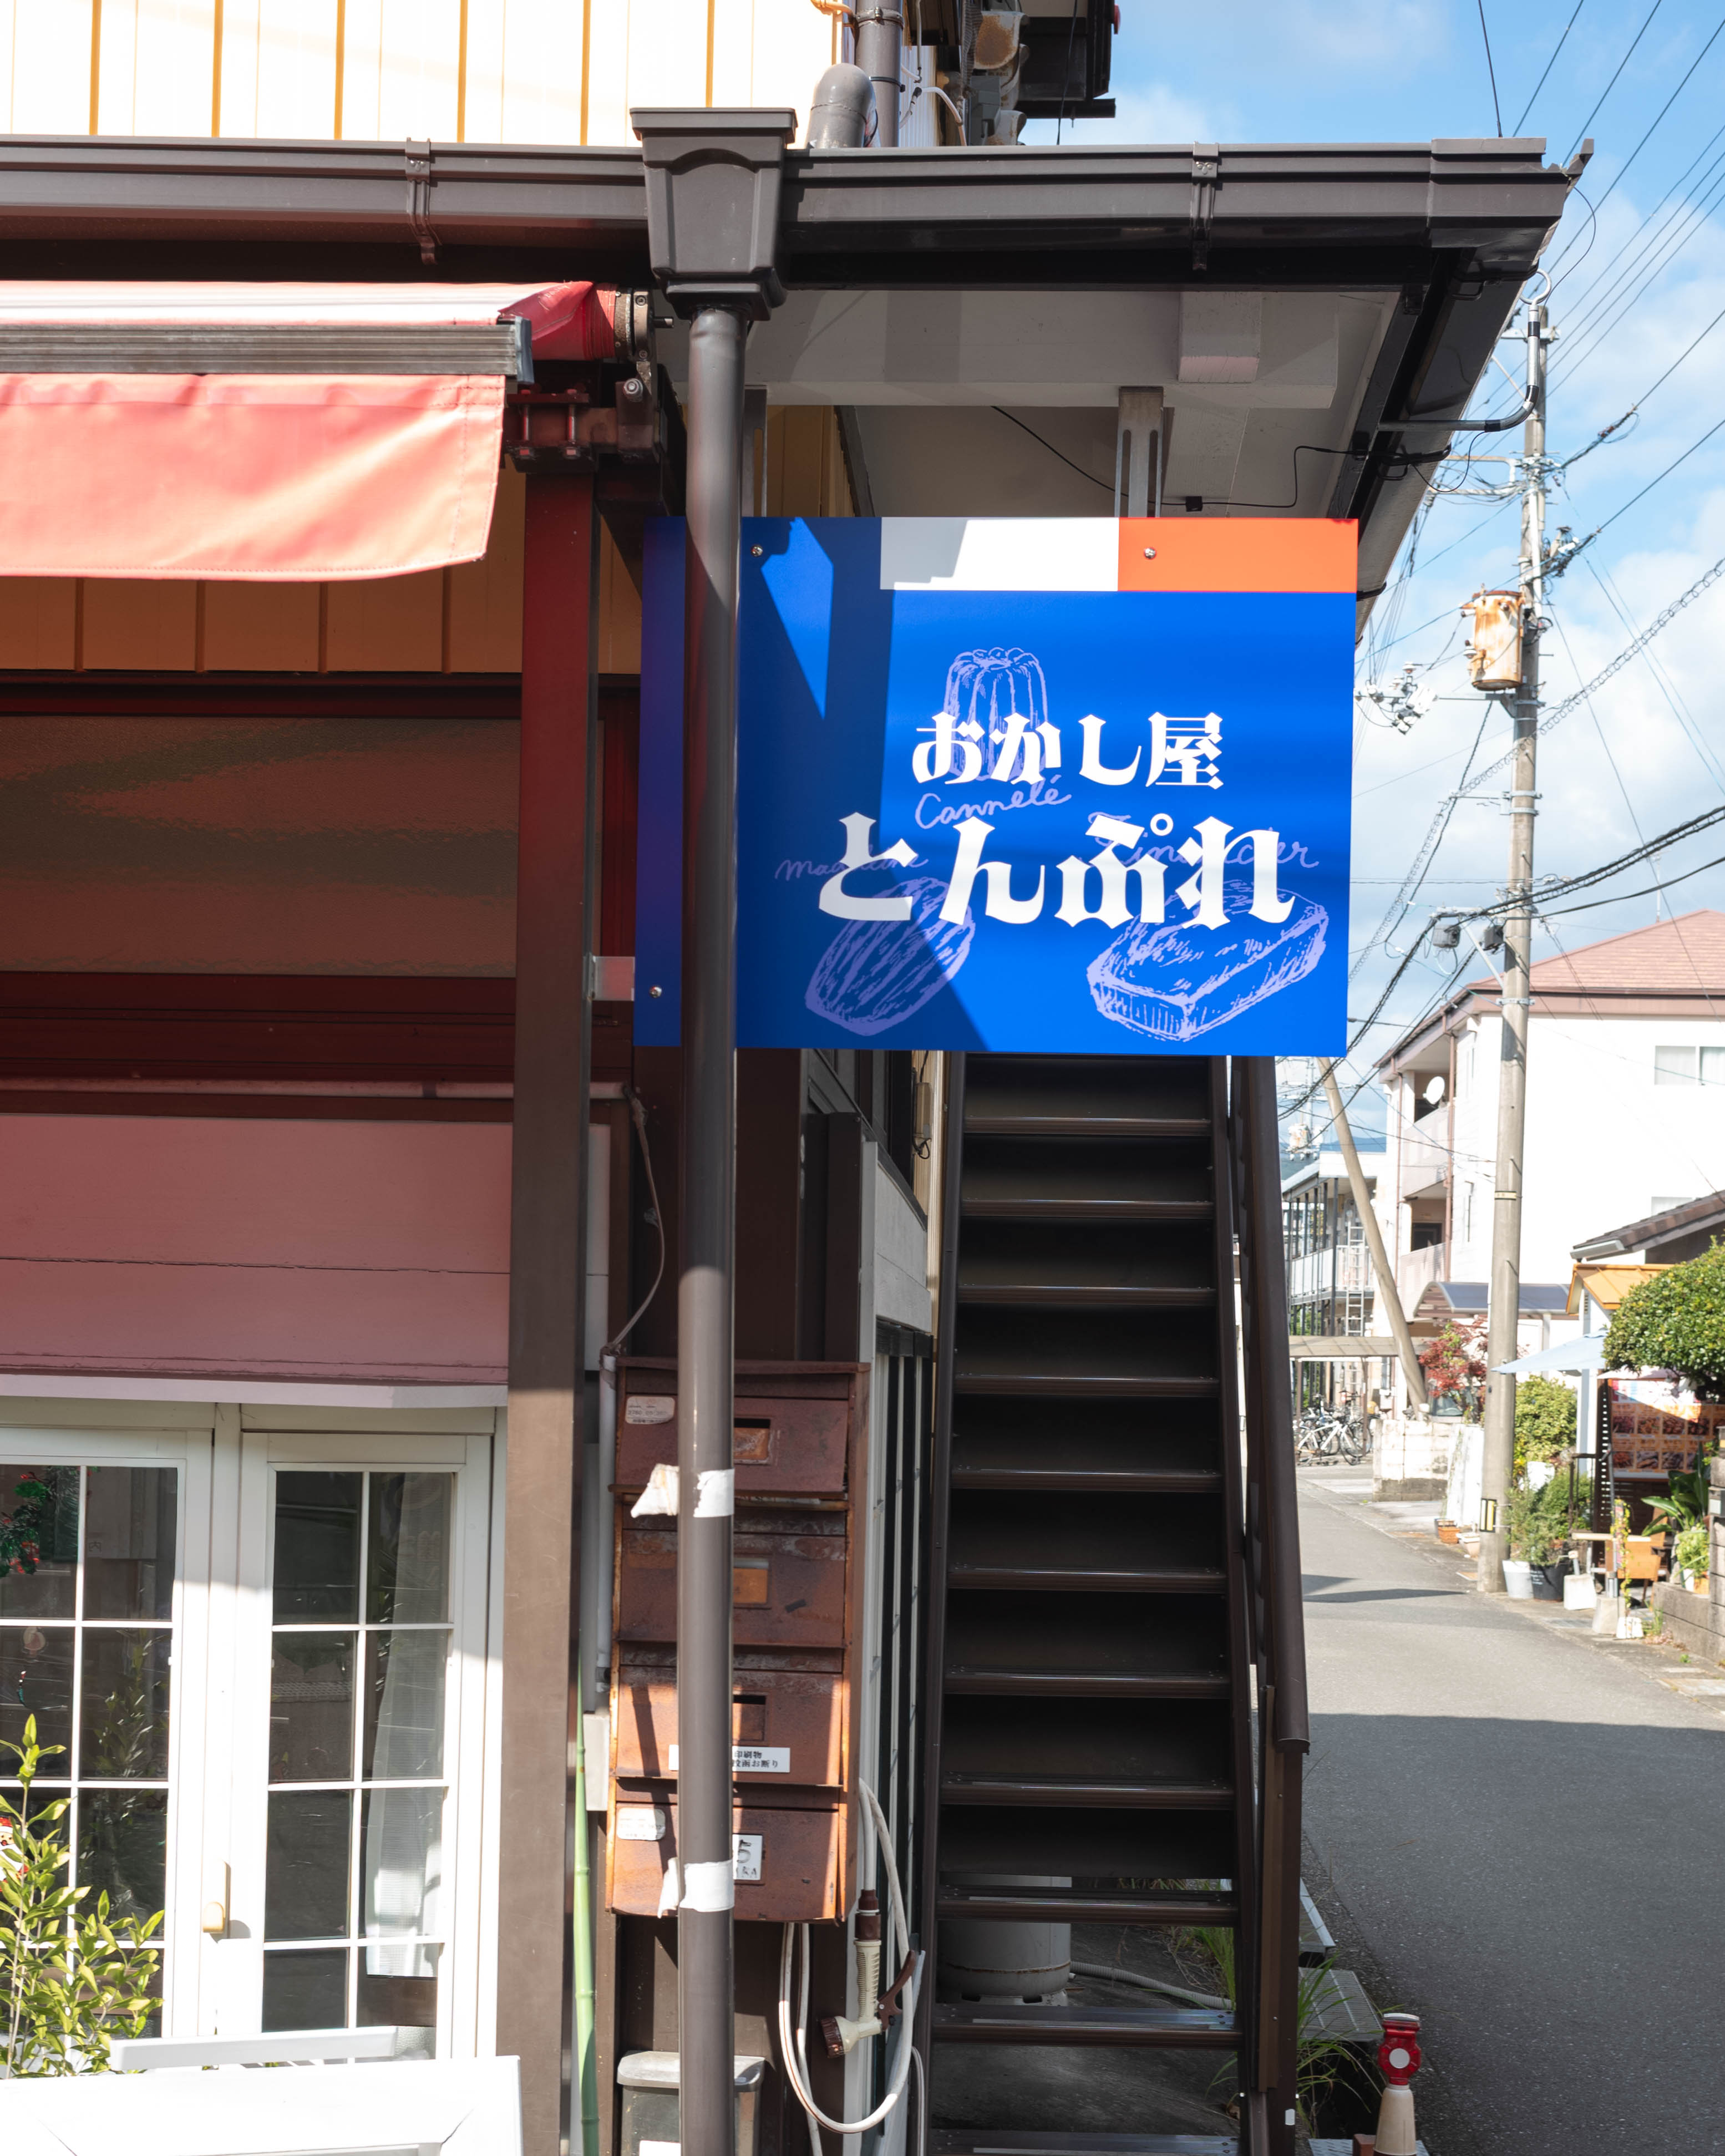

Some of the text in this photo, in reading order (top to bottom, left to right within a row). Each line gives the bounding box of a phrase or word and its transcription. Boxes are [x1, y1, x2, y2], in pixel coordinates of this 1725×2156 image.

[912, 711, 1224, 789] おかし屋
[818, 811, 1295, 930] とんぷれ
